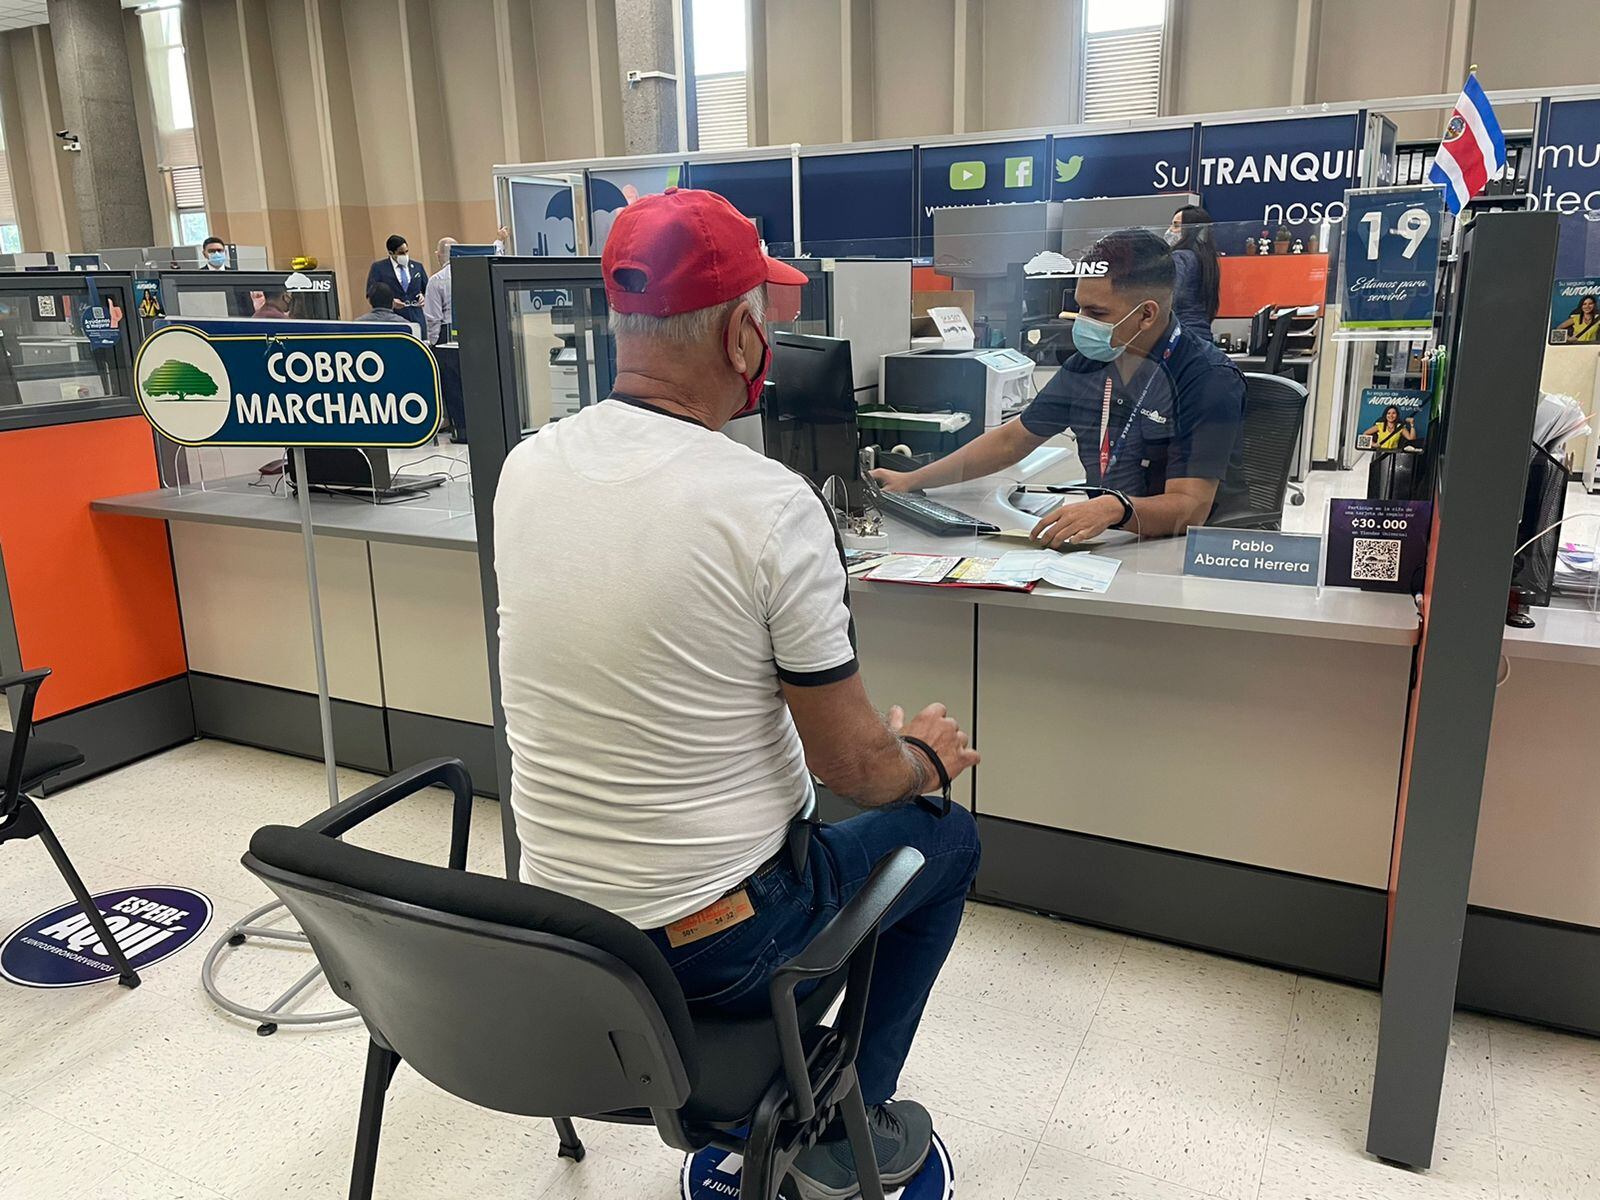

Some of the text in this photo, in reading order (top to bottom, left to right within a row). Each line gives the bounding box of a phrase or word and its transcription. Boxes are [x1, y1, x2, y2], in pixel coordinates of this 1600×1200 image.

[1152, 160, 1190, 189] Su
[1263, 200, 1347, 226] noso
[1360, 208, 1432, 260] 19
[1074, 260, 1110, 275] INS
[312, 279, 331, 290] INS
[1350, 276, 1427, 294] Estamos para
[1367, 289, 1408, 302] servirle
[267, 350, 385, 383] COBRO
[235, 392, 429, 425] MARCHAMO
[1368, 396, 1419, 407] AUTOMÓVIL
[1231, 539, 1274, 553] Pablo
[1193, 553, 1310, 573] Abarca Herrera
[110, 896, 190, 927] ESPERE
